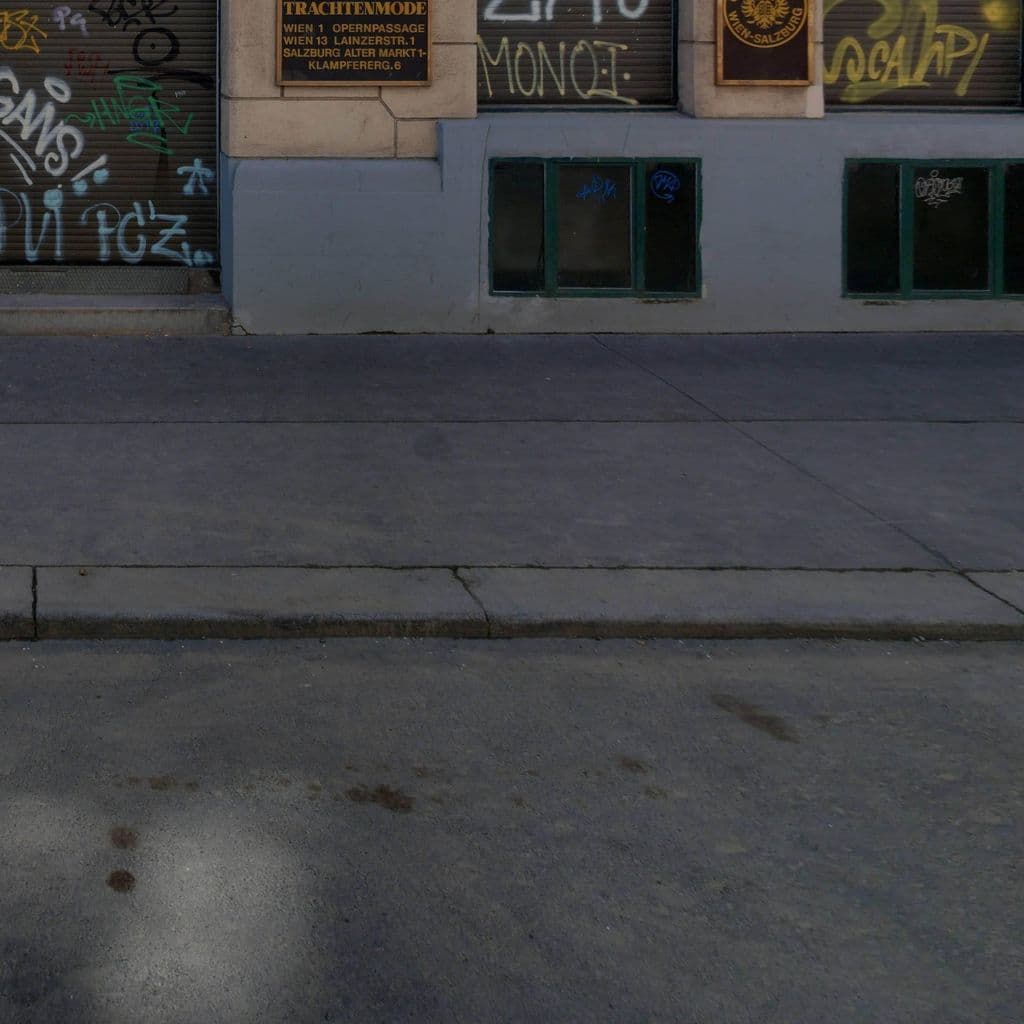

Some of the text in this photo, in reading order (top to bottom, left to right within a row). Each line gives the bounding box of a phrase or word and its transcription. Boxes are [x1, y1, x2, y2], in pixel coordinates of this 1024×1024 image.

[284, 1, 426, 16] TRACHTENMODE
[284, 23, 425, 33] WIEN 1 OPERNPASSAGE
[284, 36, 313, 46] WIEN
[316, 36, 328, 46] 13
[283, 48, 340, 58] SALZBURG
[344, 48, 376, 58] ALTER
[379, 48, 416, 58] MARKT
